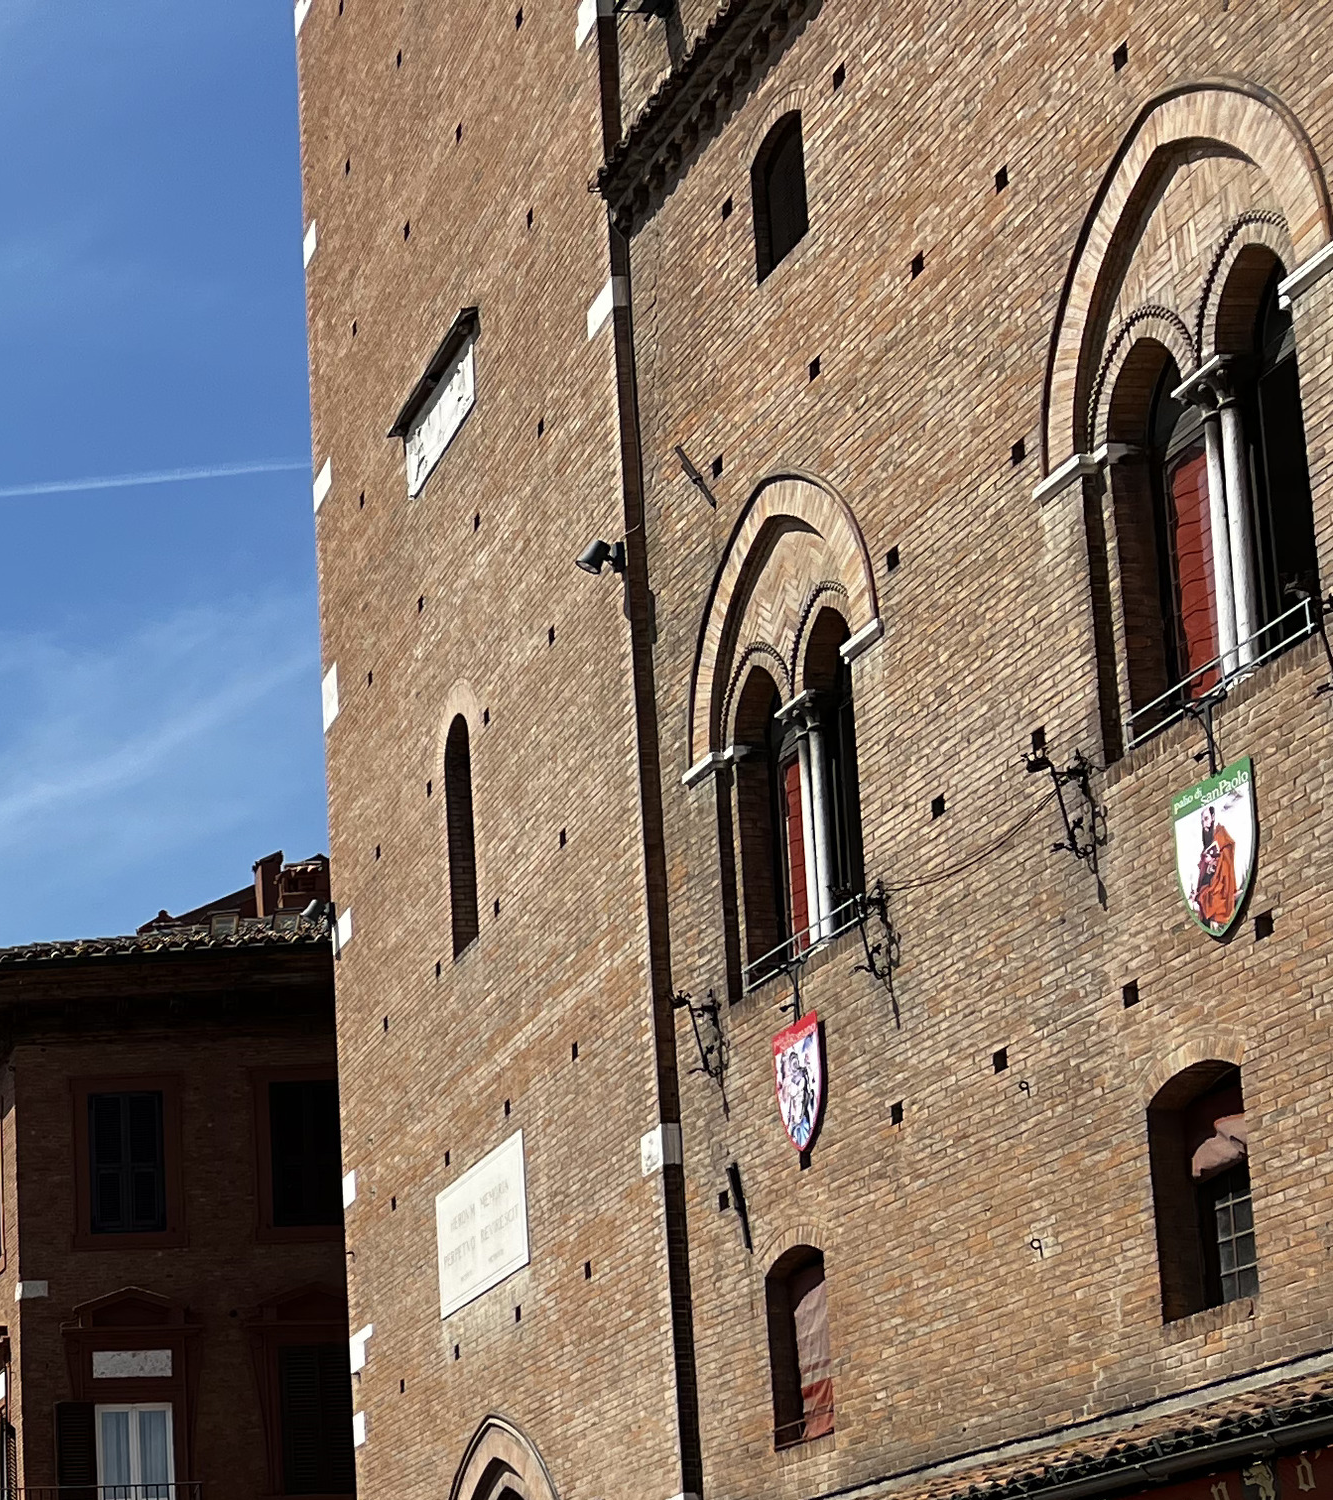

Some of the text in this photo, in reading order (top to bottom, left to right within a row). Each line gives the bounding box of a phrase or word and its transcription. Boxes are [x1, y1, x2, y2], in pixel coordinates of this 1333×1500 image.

[1173, 787, 1203, 815] palio di
[1201, 770, 1248, 806] sanPaolo
